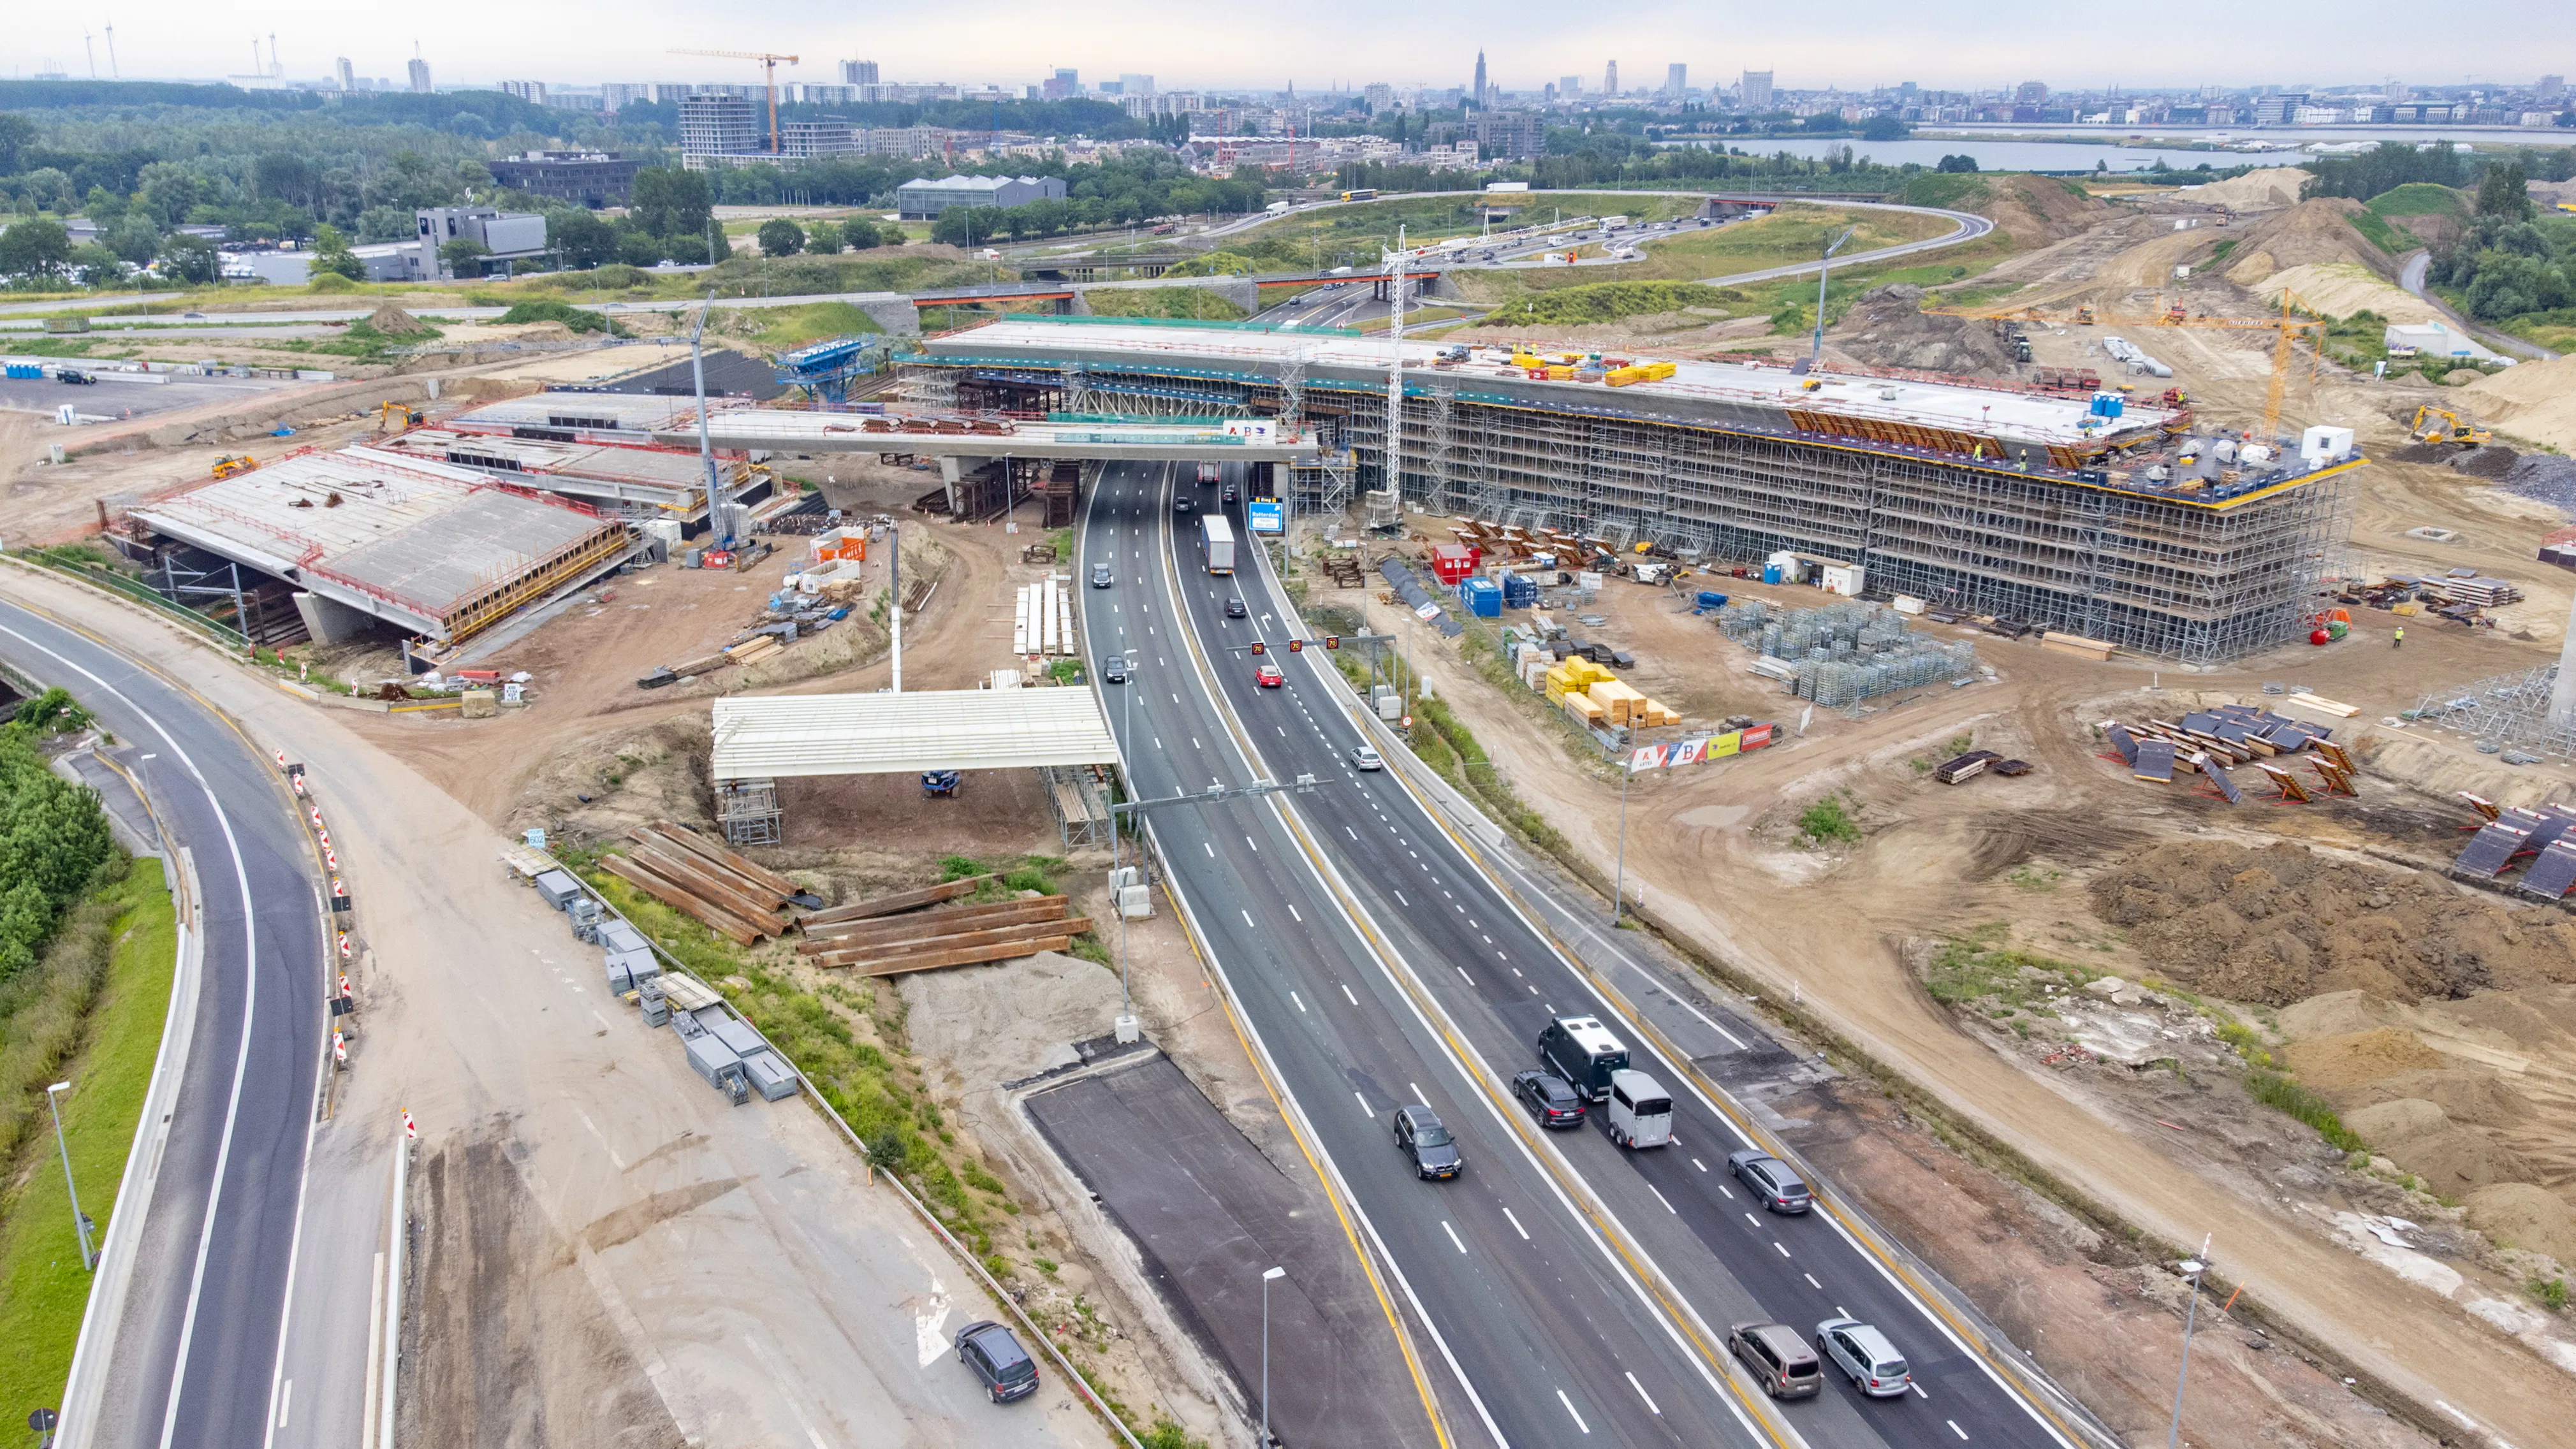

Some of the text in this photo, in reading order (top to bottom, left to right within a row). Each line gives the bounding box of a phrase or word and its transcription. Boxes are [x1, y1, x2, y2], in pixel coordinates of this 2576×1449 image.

[1244, 426, 1252, 437] B
[1683, 745, 1694, 761] B
[530, 835, 544, 844] 602
